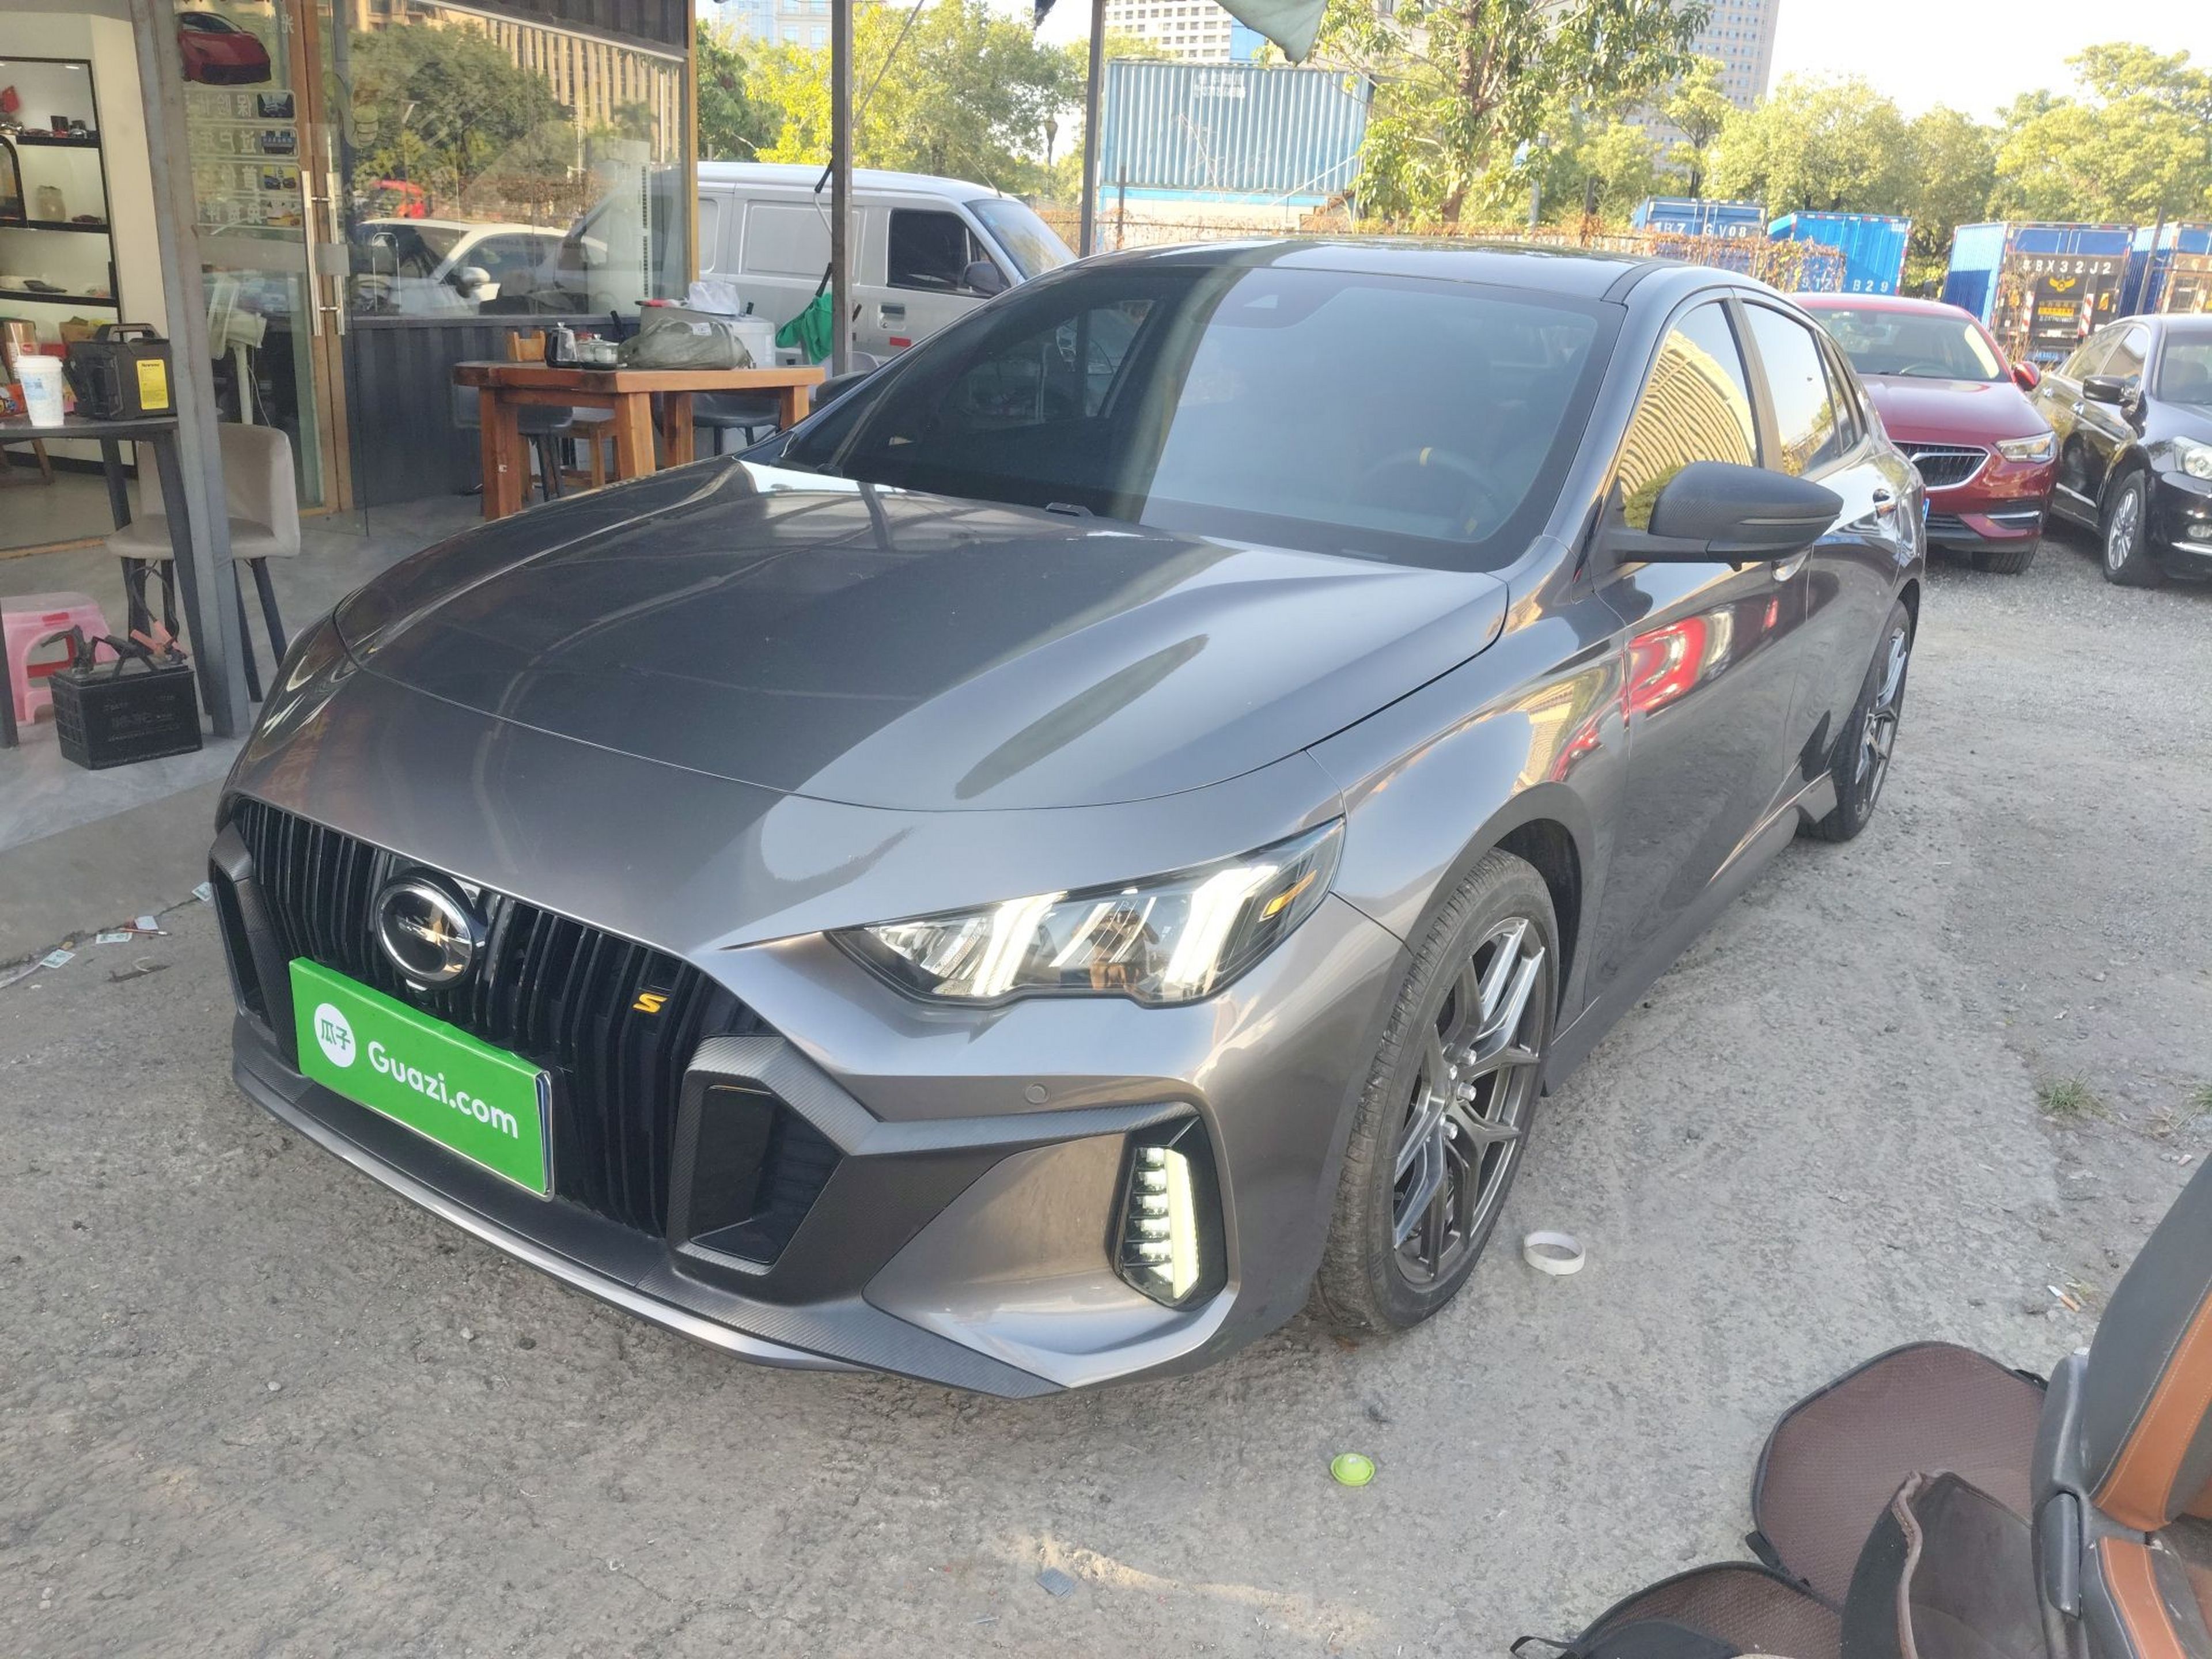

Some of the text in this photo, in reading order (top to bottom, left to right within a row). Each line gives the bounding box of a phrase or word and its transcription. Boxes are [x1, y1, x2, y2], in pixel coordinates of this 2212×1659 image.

[632, 993, 668, 1013] S
[321, 1018, 351, 1050] 瓜子
[368, 1040, 519, 1139] Guazi.com
